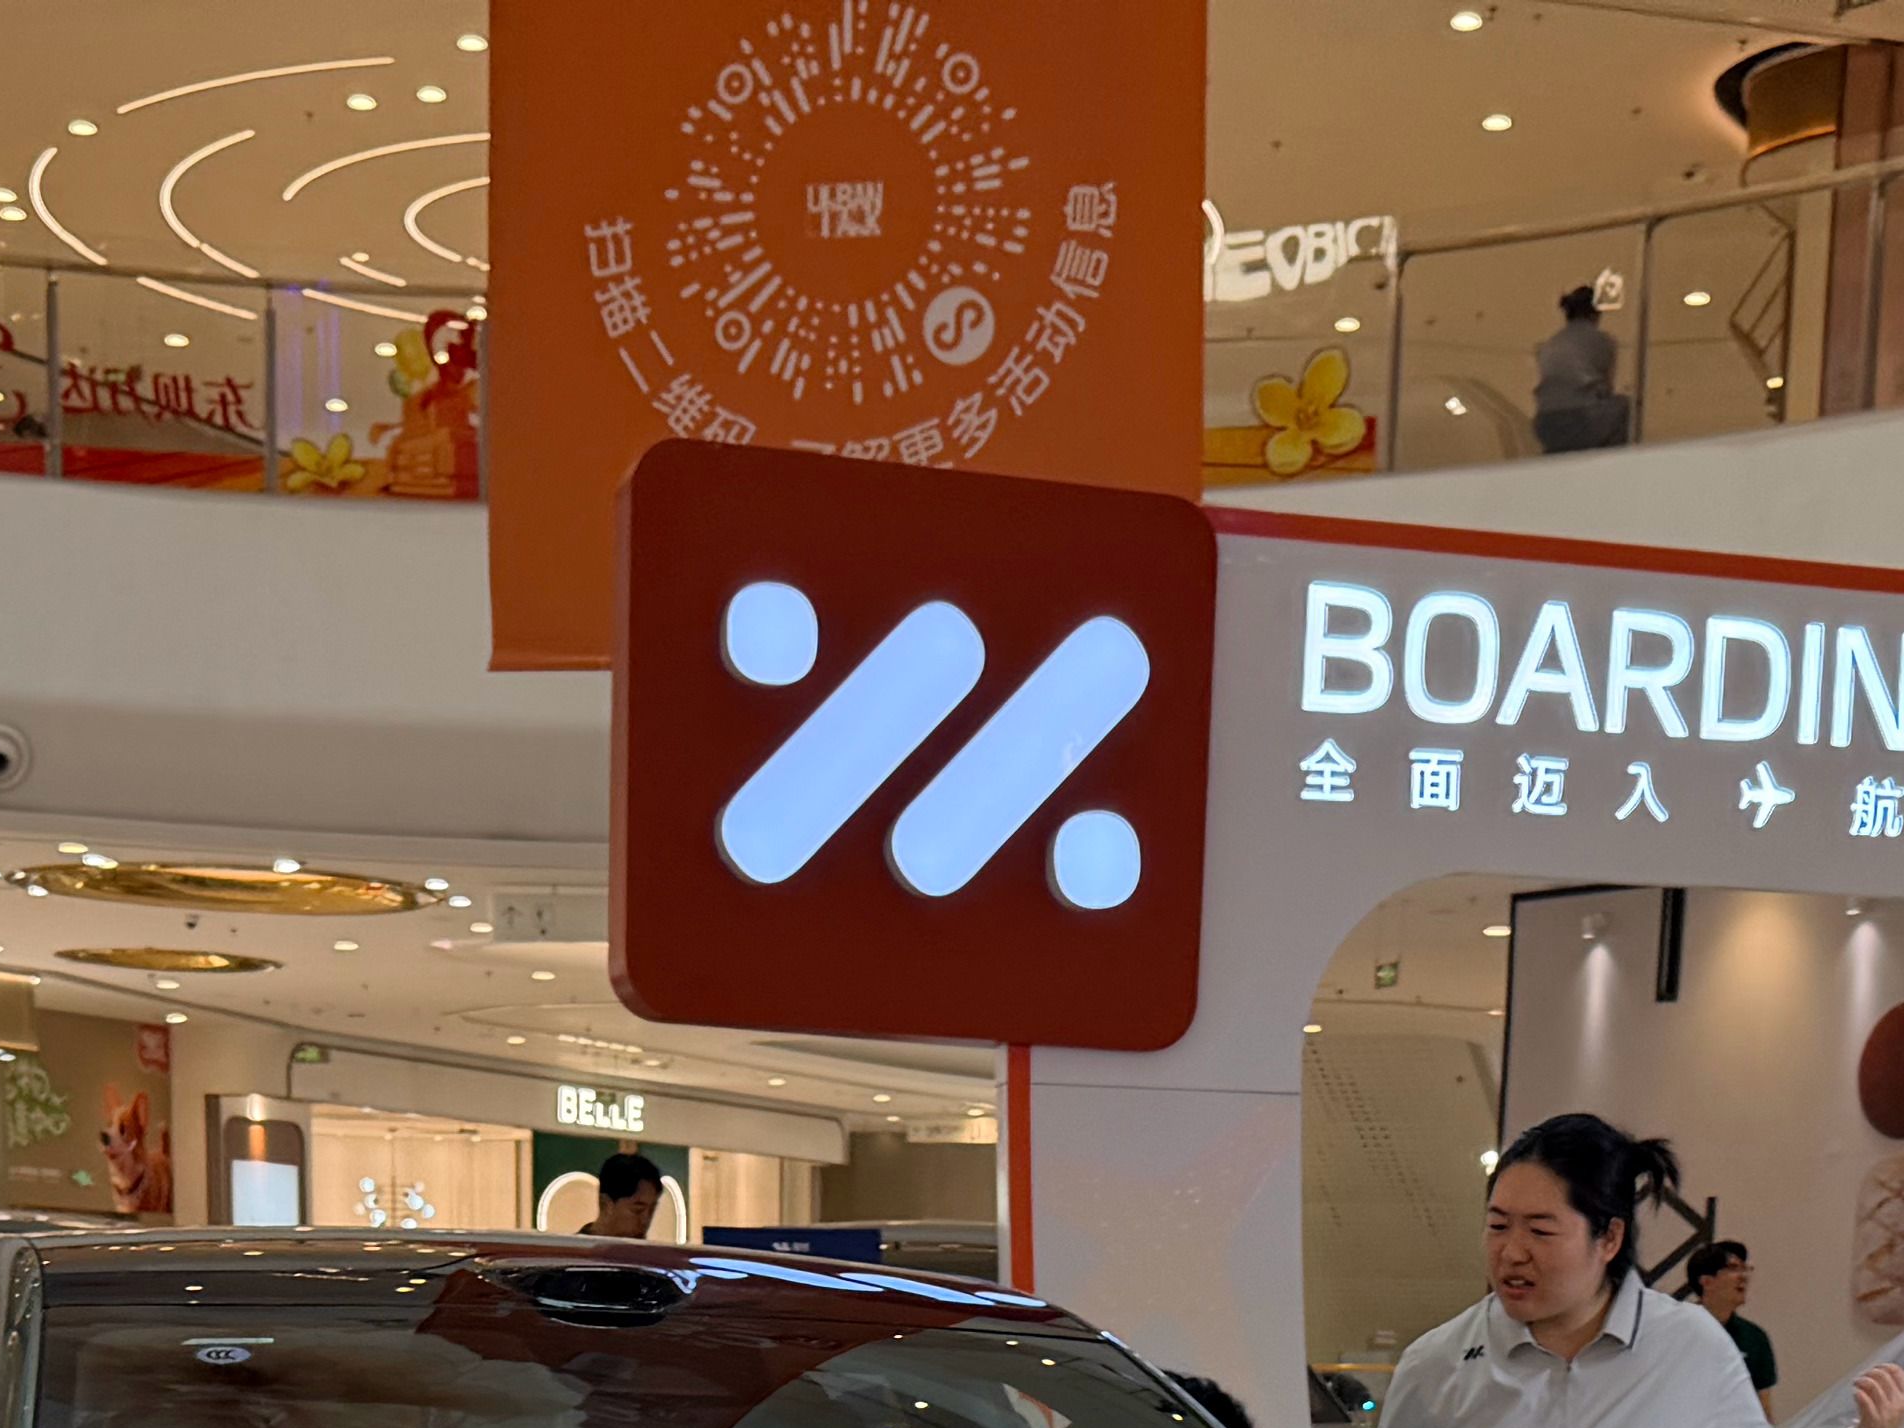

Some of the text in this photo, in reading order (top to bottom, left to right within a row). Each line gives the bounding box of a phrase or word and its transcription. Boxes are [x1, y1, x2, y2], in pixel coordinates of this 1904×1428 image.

[1297, 738, 1671, 824] 全面迈入
[557, 1084, 645, 1132] BELLE
